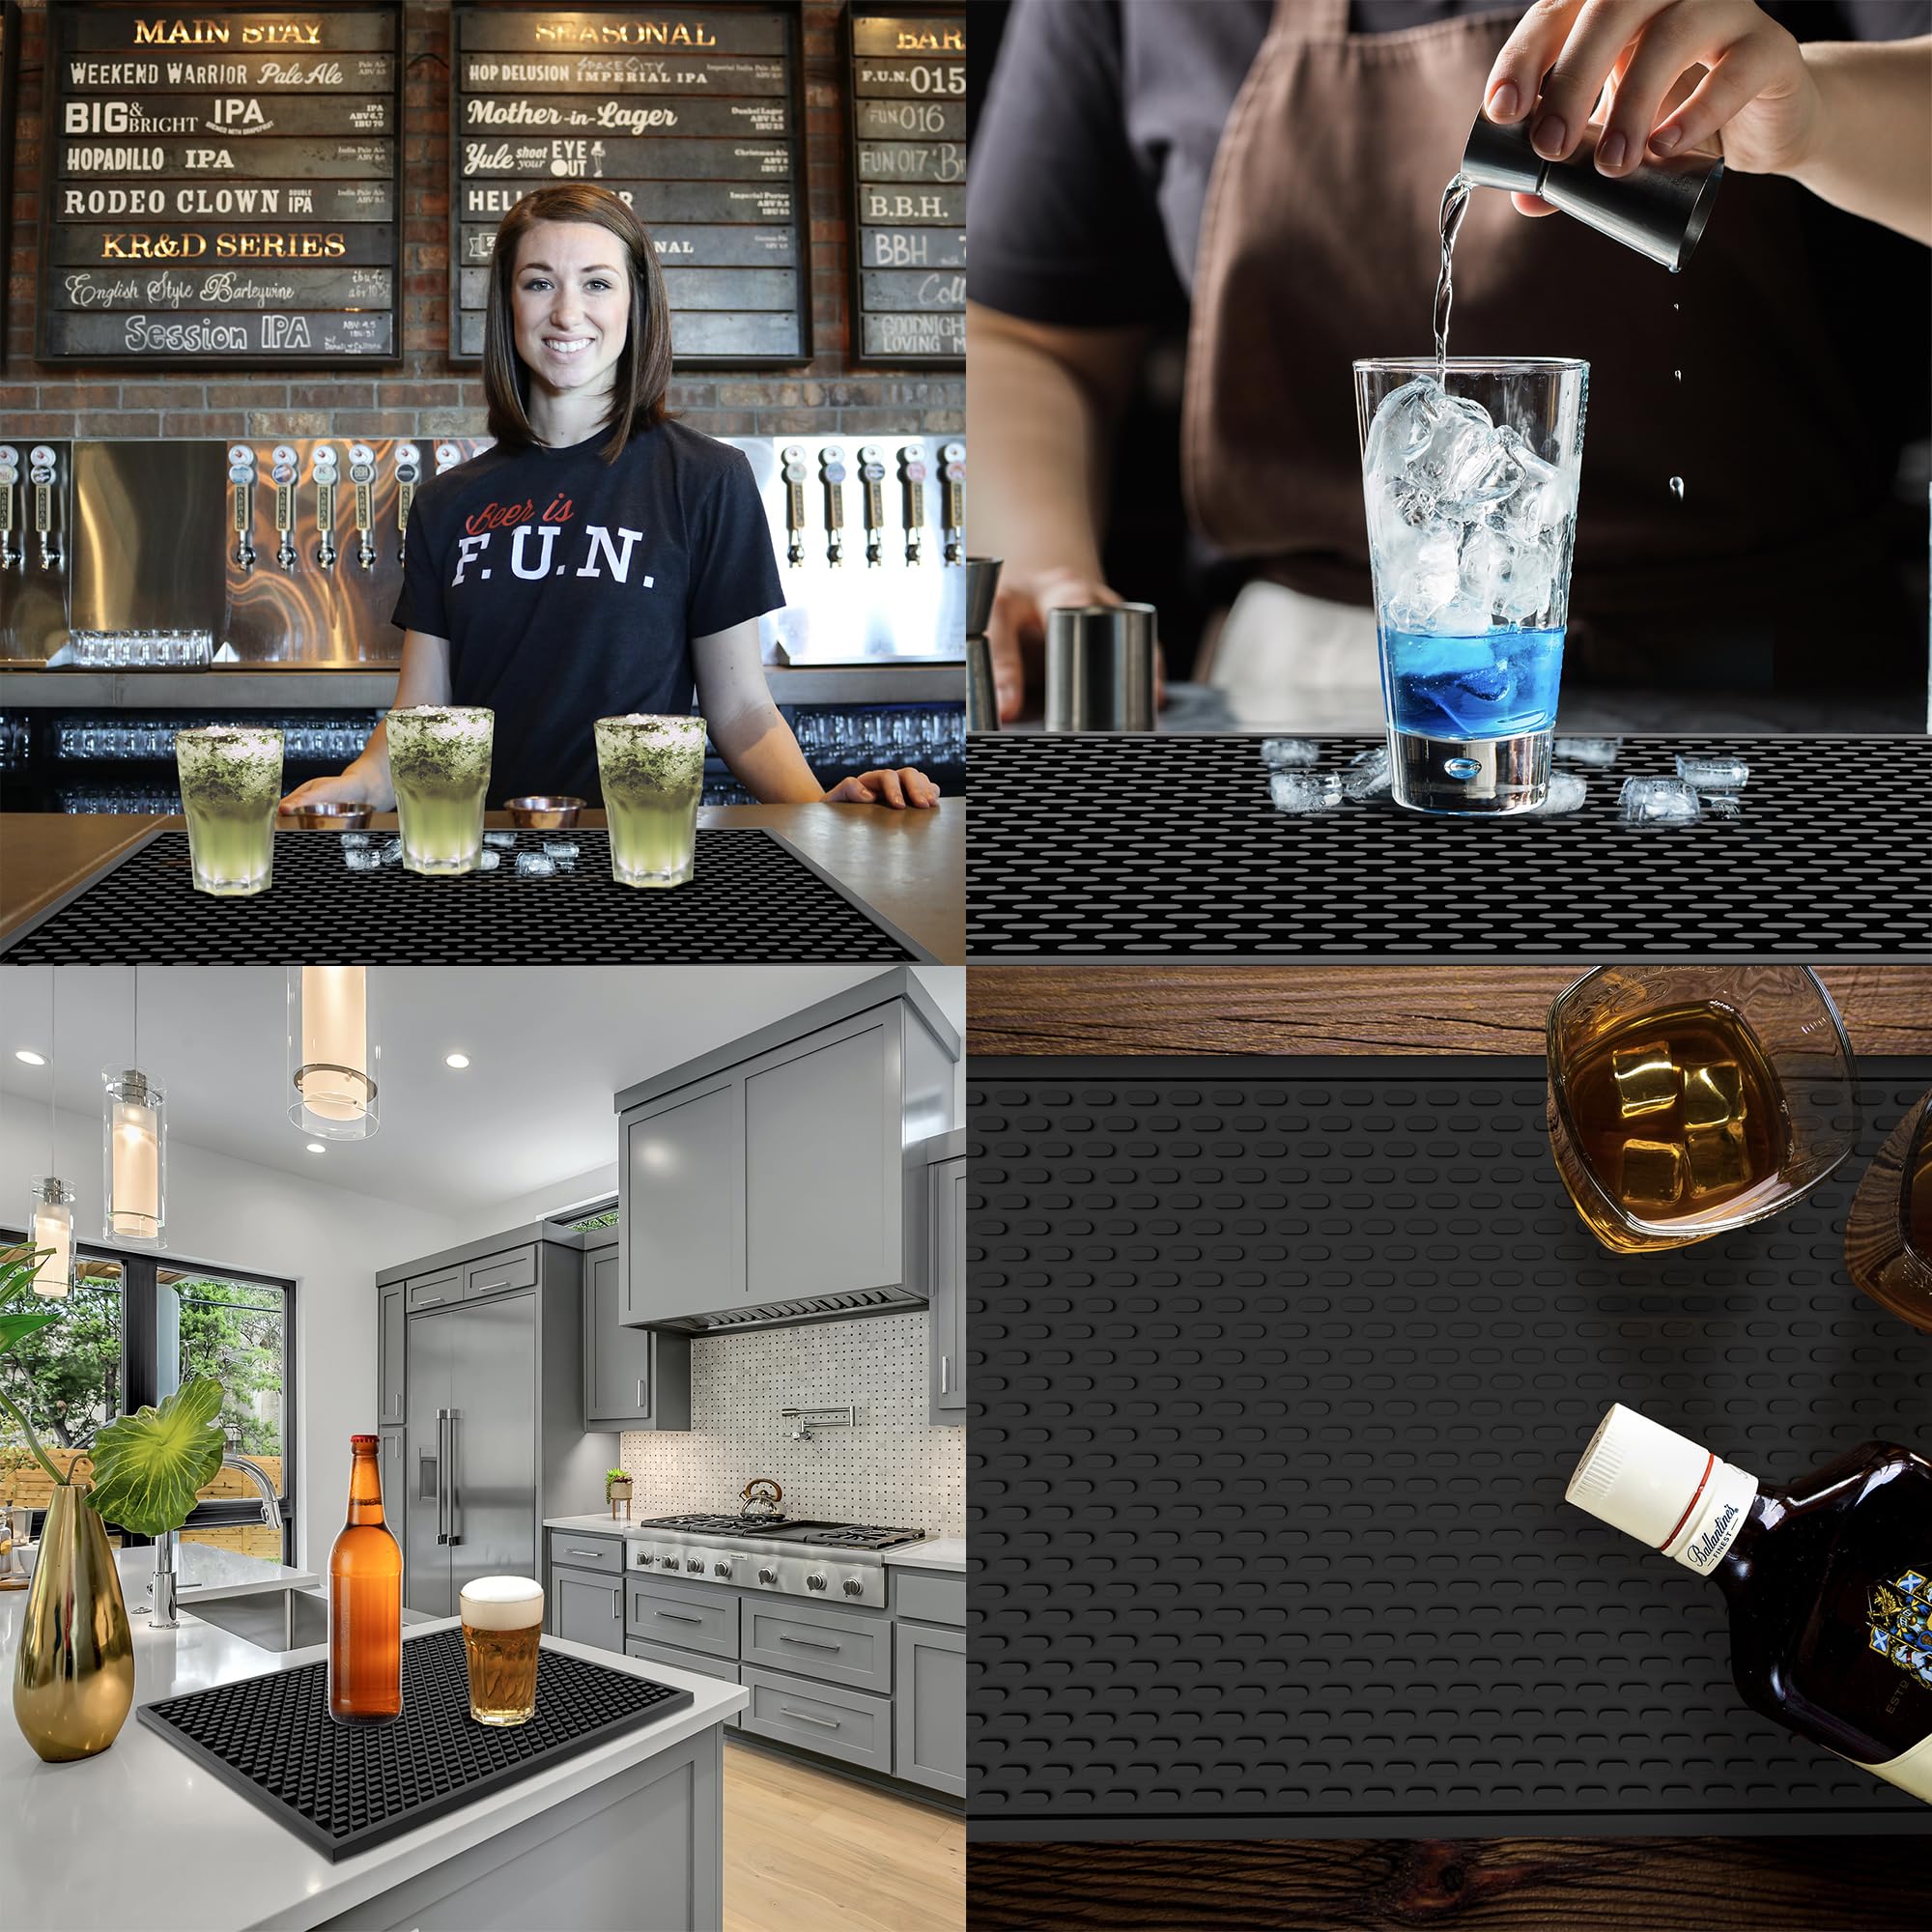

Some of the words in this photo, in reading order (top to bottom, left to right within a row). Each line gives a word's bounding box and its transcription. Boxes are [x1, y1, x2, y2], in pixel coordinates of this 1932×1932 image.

[133, 19, 230, 44] MAIN
[242, 19, 323, 44] STAY
[535, 20, 716, 46] SEASONAL
[71, 62, 158, 85] WEEKEND
[257, 62, 304, 85] Pale
[303, 62, 344, 85] Ale
[469, 65, 498, 81] HOP
[501, 65, 570, 82] DELUSION
[577, 56, 624, 73] SPACE
[577, 71, 670, 83] IMPERIAL
[676, 72, 708, 84] IPA
[910, 66, 966, 94] 015
[65, 101, 128, 133] BIG
[129, 101, 144, 117] &
[214, 99, 265, 124] IPA
[869, 110, 898, 124] FUN
[899, 103, 946, 132] 016
[128, 117, 199, 133] BRIGHT
[67, 148, 164, 171] HOPADILLO
[185, 150, 235, 169] IPA
[464, 143, 514, 175] Yule
[516, 147, 548, 158] shoot
[552, 140, 587, 159] EYE
[517, 160, 546, 170] your
[861, 151, 895, 172] FUN
[897, 149, 929, 172] 017
[65, 189, 165, 213] RODEO
[177, 189, 279, 213] CLOWN
[289, 196, 313, 213] IPA
[868, 195, 950, 218] B.B.H.
[100, 232, 207, 259] KR&D
[215, 232, 346, 259] SERIES
[875, 234, 928, 266] BBH
[65, 273, 139, 308] English
[146, 270, 194, 309] Style
[199, 270, 295, 308] Barleywine
[125, 314, 247, 352] Session
[261, 314, 312, 349] IPA
[882, 336, 942, 354] LOVING
[542, 493, 574, 522] is
[451, 525, 655, 588] F.U.N.
[1687, 1503, 1736, 1568] Ballantine's
[1713, 1530, 1733, 1559] FINEST
[1885, 1679, 1910, 1715] ESTD
